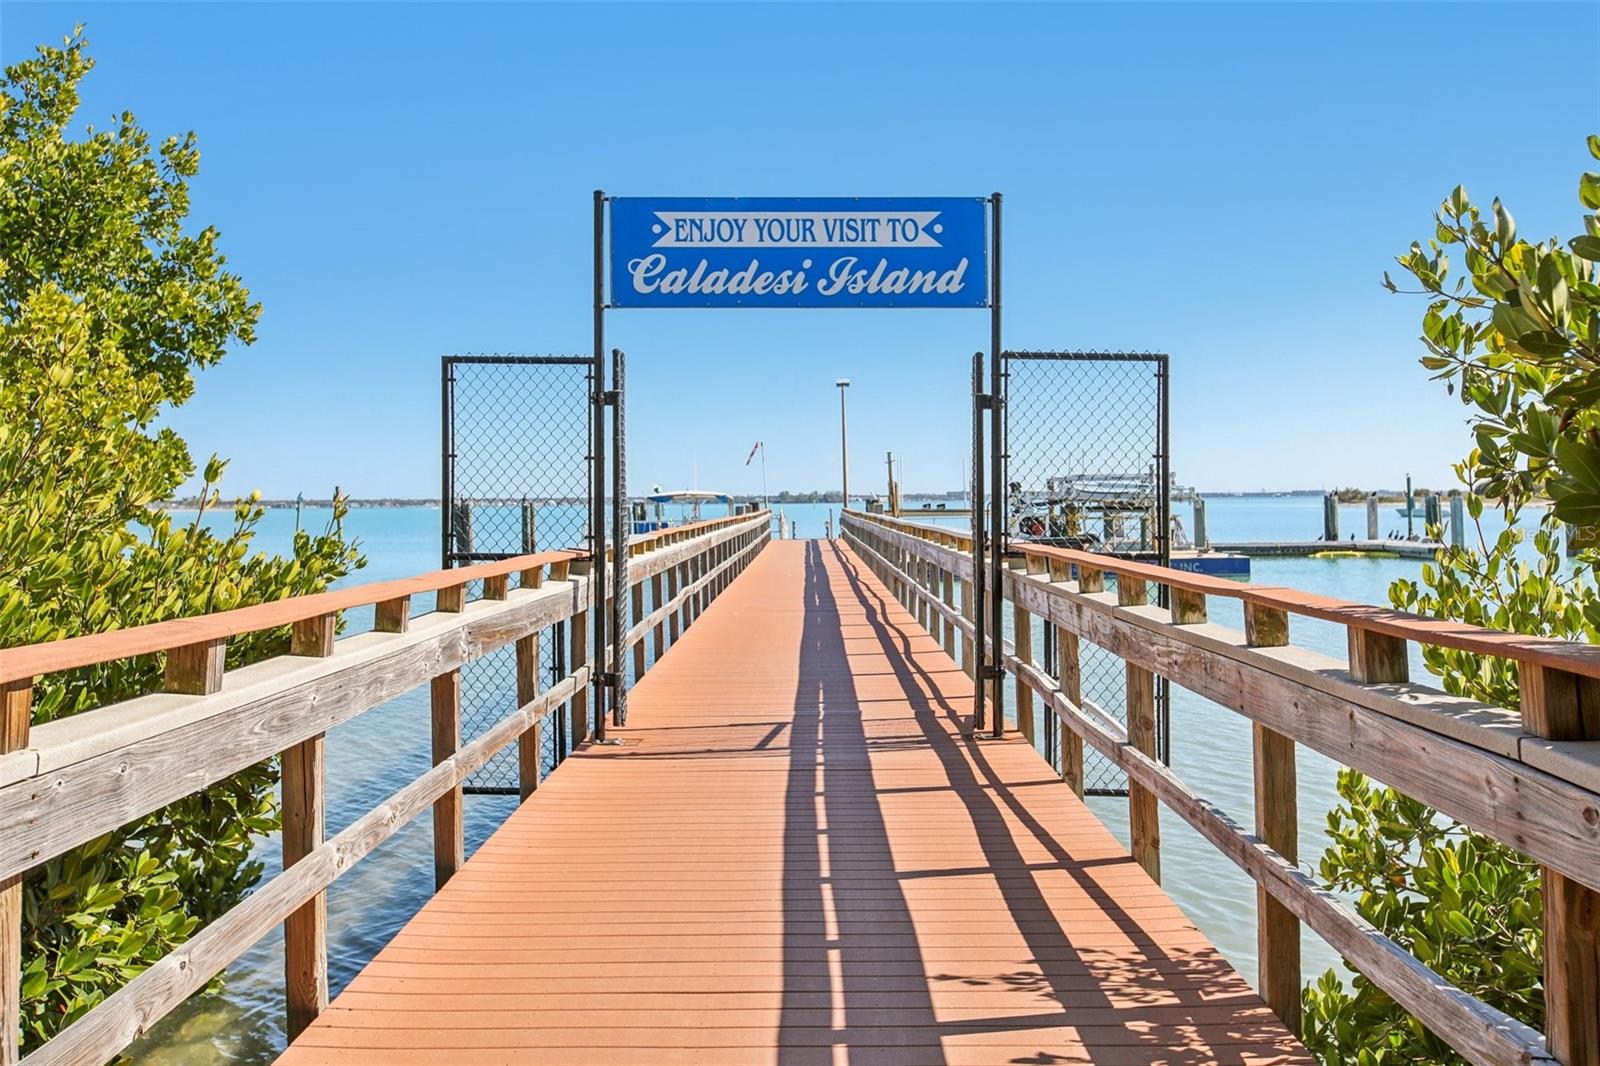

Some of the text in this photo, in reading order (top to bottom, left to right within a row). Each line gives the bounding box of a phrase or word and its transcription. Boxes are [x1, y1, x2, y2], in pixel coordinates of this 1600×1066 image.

[673, 218, 919, 242] ENJOY YOUR VISIT TO
[627, 253, 969, 296] Caladesi Island
